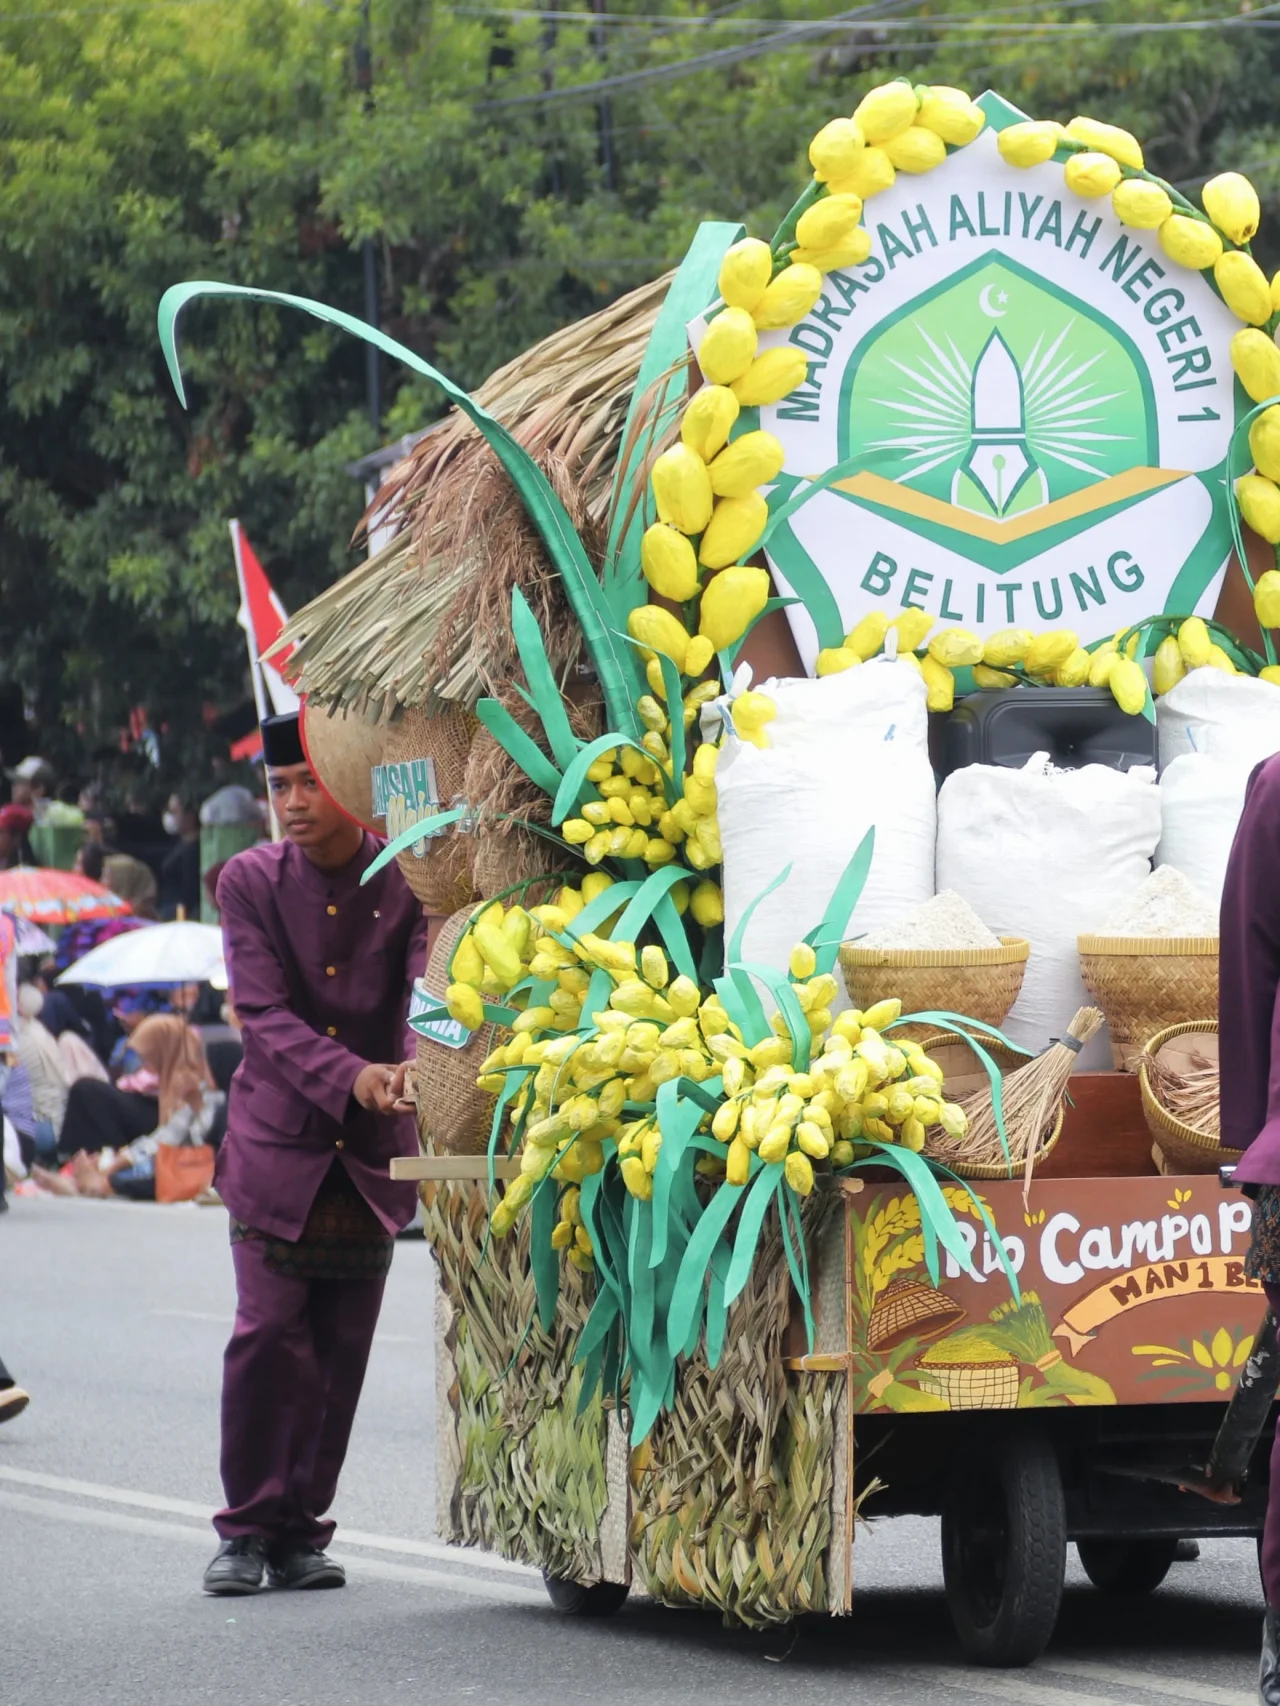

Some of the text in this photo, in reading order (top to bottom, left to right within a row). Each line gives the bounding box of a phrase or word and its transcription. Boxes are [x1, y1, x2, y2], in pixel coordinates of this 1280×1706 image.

[775, 190, 1221, 423] MADRASAH ALIYAH NEGERI 1
[859, 550, 1145, 624] BELITUNG
[1039, 1211, 1212, 1285] Campo
[1109, 1261, 1189, 1306] MAN
[1197, 1261, 1214, 1288] 1
